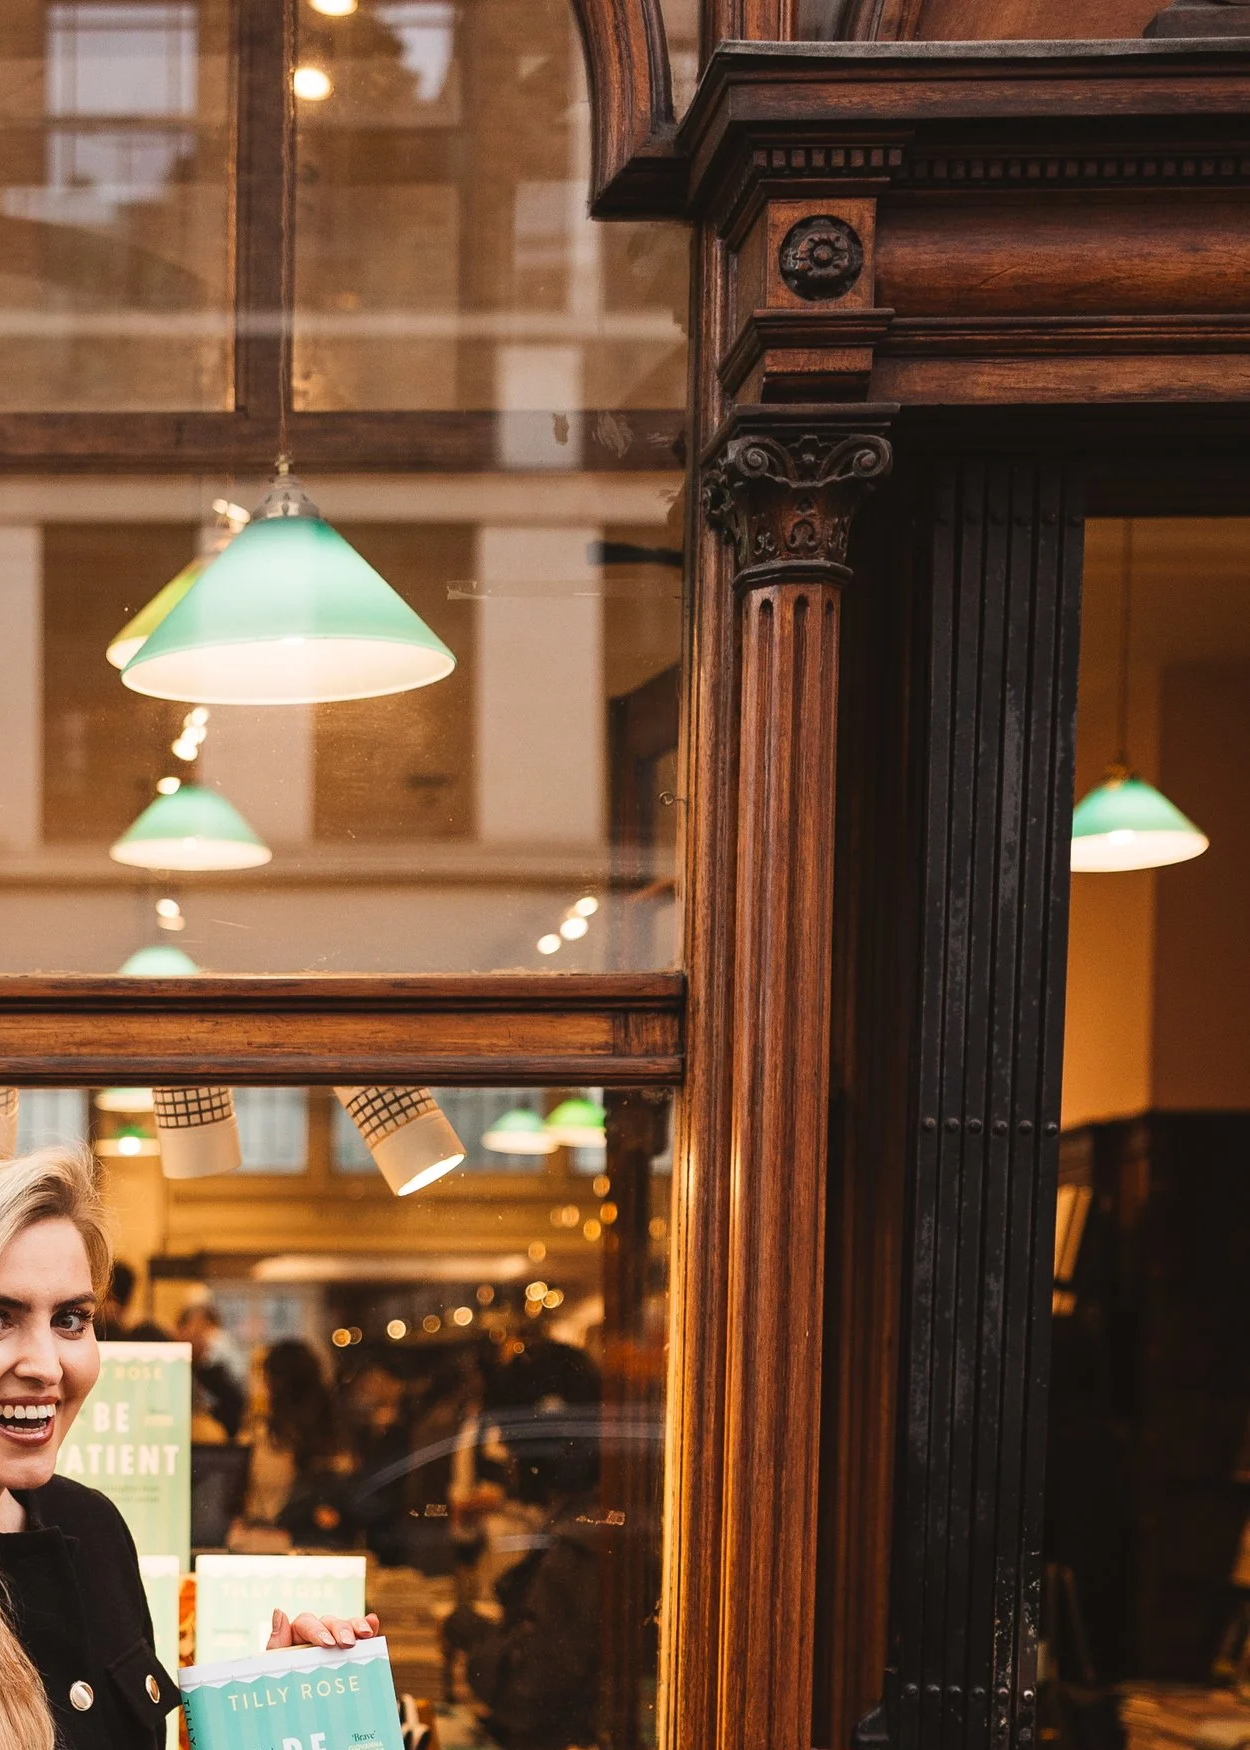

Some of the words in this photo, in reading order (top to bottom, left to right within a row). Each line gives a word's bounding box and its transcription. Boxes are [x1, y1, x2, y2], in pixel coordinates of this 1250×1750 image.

[93, 1401, 130, 1434] BE
[58, 1443, 179, 1476] ATIENT
[228, 1686, 290, 1711] TILLY
[301, 1676, 361, 1700] ROSE
